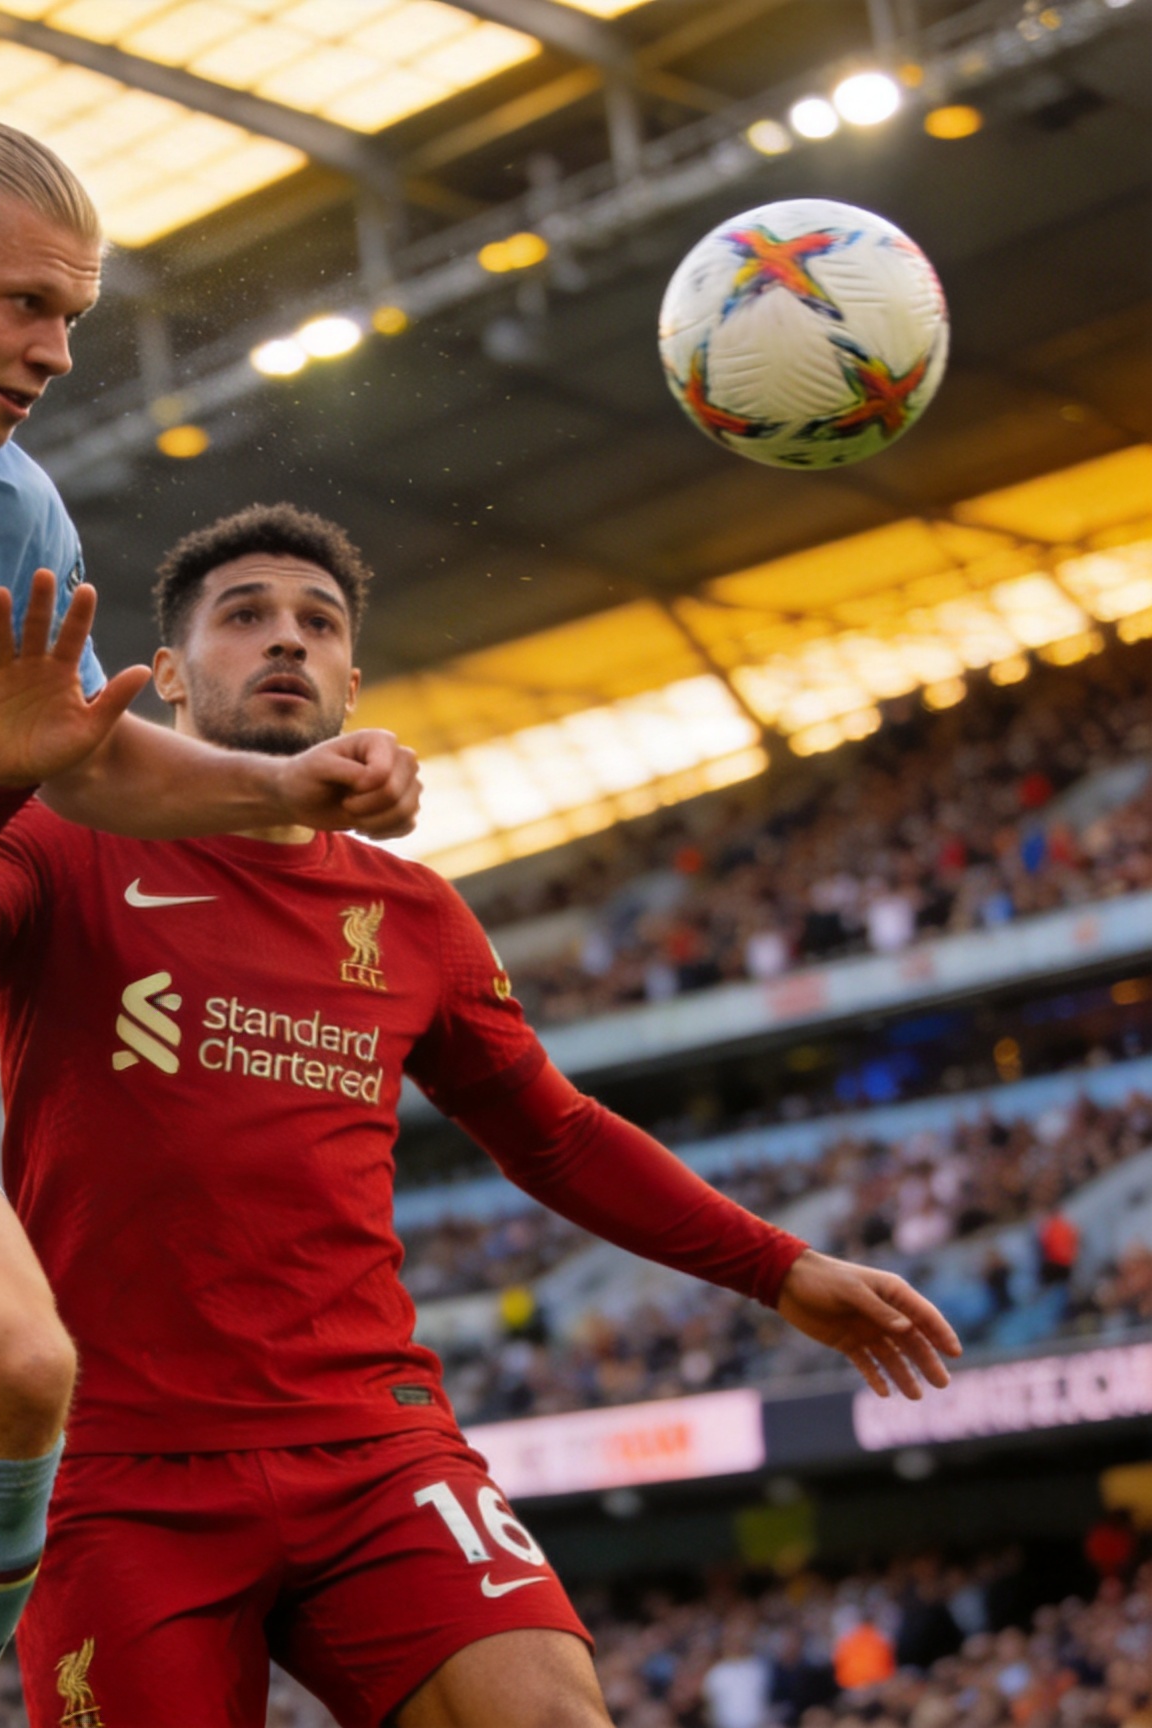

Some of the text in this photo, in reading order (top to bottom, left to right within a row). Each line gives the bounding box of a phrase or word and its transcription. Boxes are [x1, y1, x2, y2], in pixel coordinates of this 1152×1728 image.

[202, 996, 380, 1062] Standard
[199, 1036, 383, 1105] Chartered
[413, 1481, 546, 1566] 16
